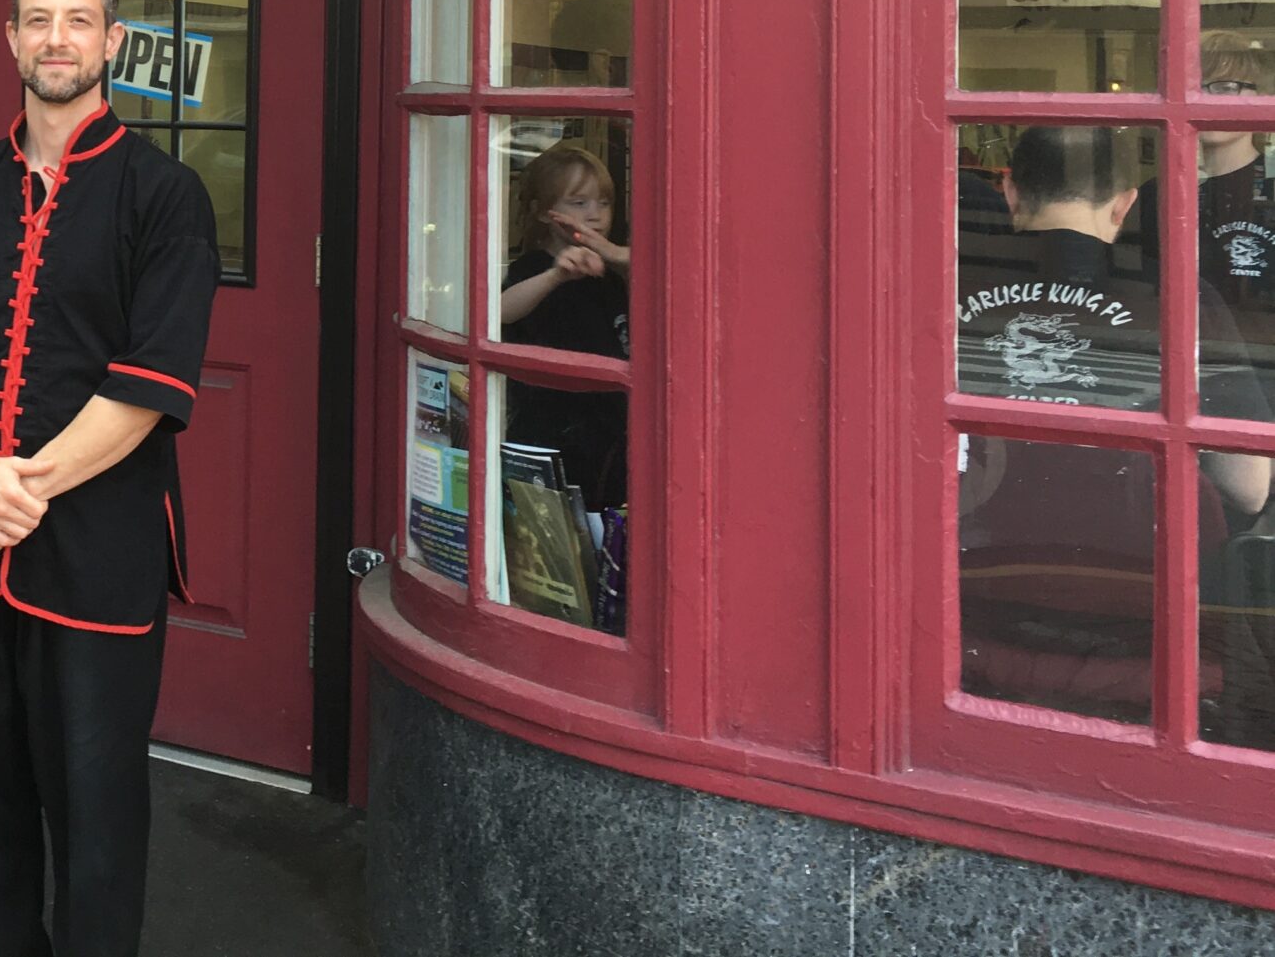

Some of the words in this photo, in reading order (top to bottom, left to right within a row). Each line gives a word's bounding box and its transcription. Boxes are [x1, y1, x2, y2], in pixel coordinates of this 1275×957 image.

[958, 282, 1044, 323] CARLISLE
[1048, 282, 1104, 313] KUNG
[1100, 301, 1133, 326] FU
